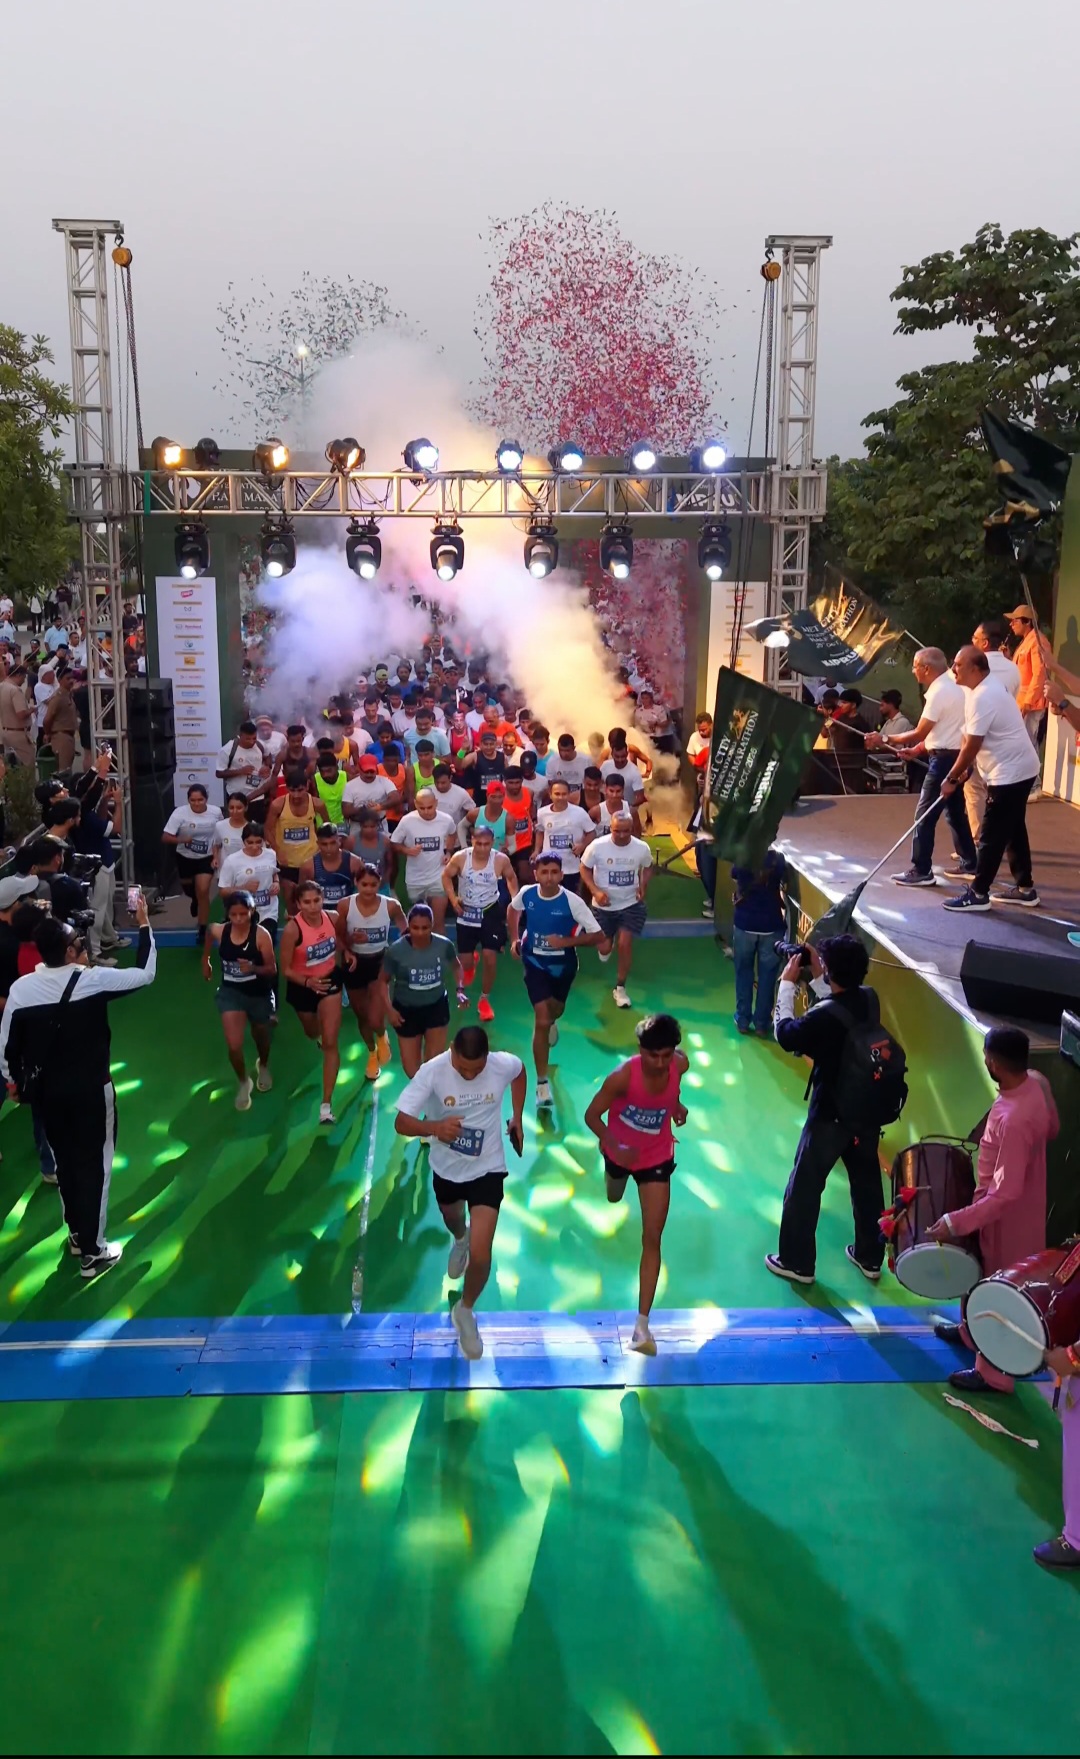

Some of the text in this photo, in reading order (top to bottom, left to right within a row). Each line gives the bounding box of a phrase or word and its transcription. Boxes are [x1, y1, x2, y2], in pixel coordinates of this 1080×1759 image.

[720, 771, 736, 799] HALF
[732, 710, 759, 770] MARATHON
[418, 974, 436, 982] 2505
